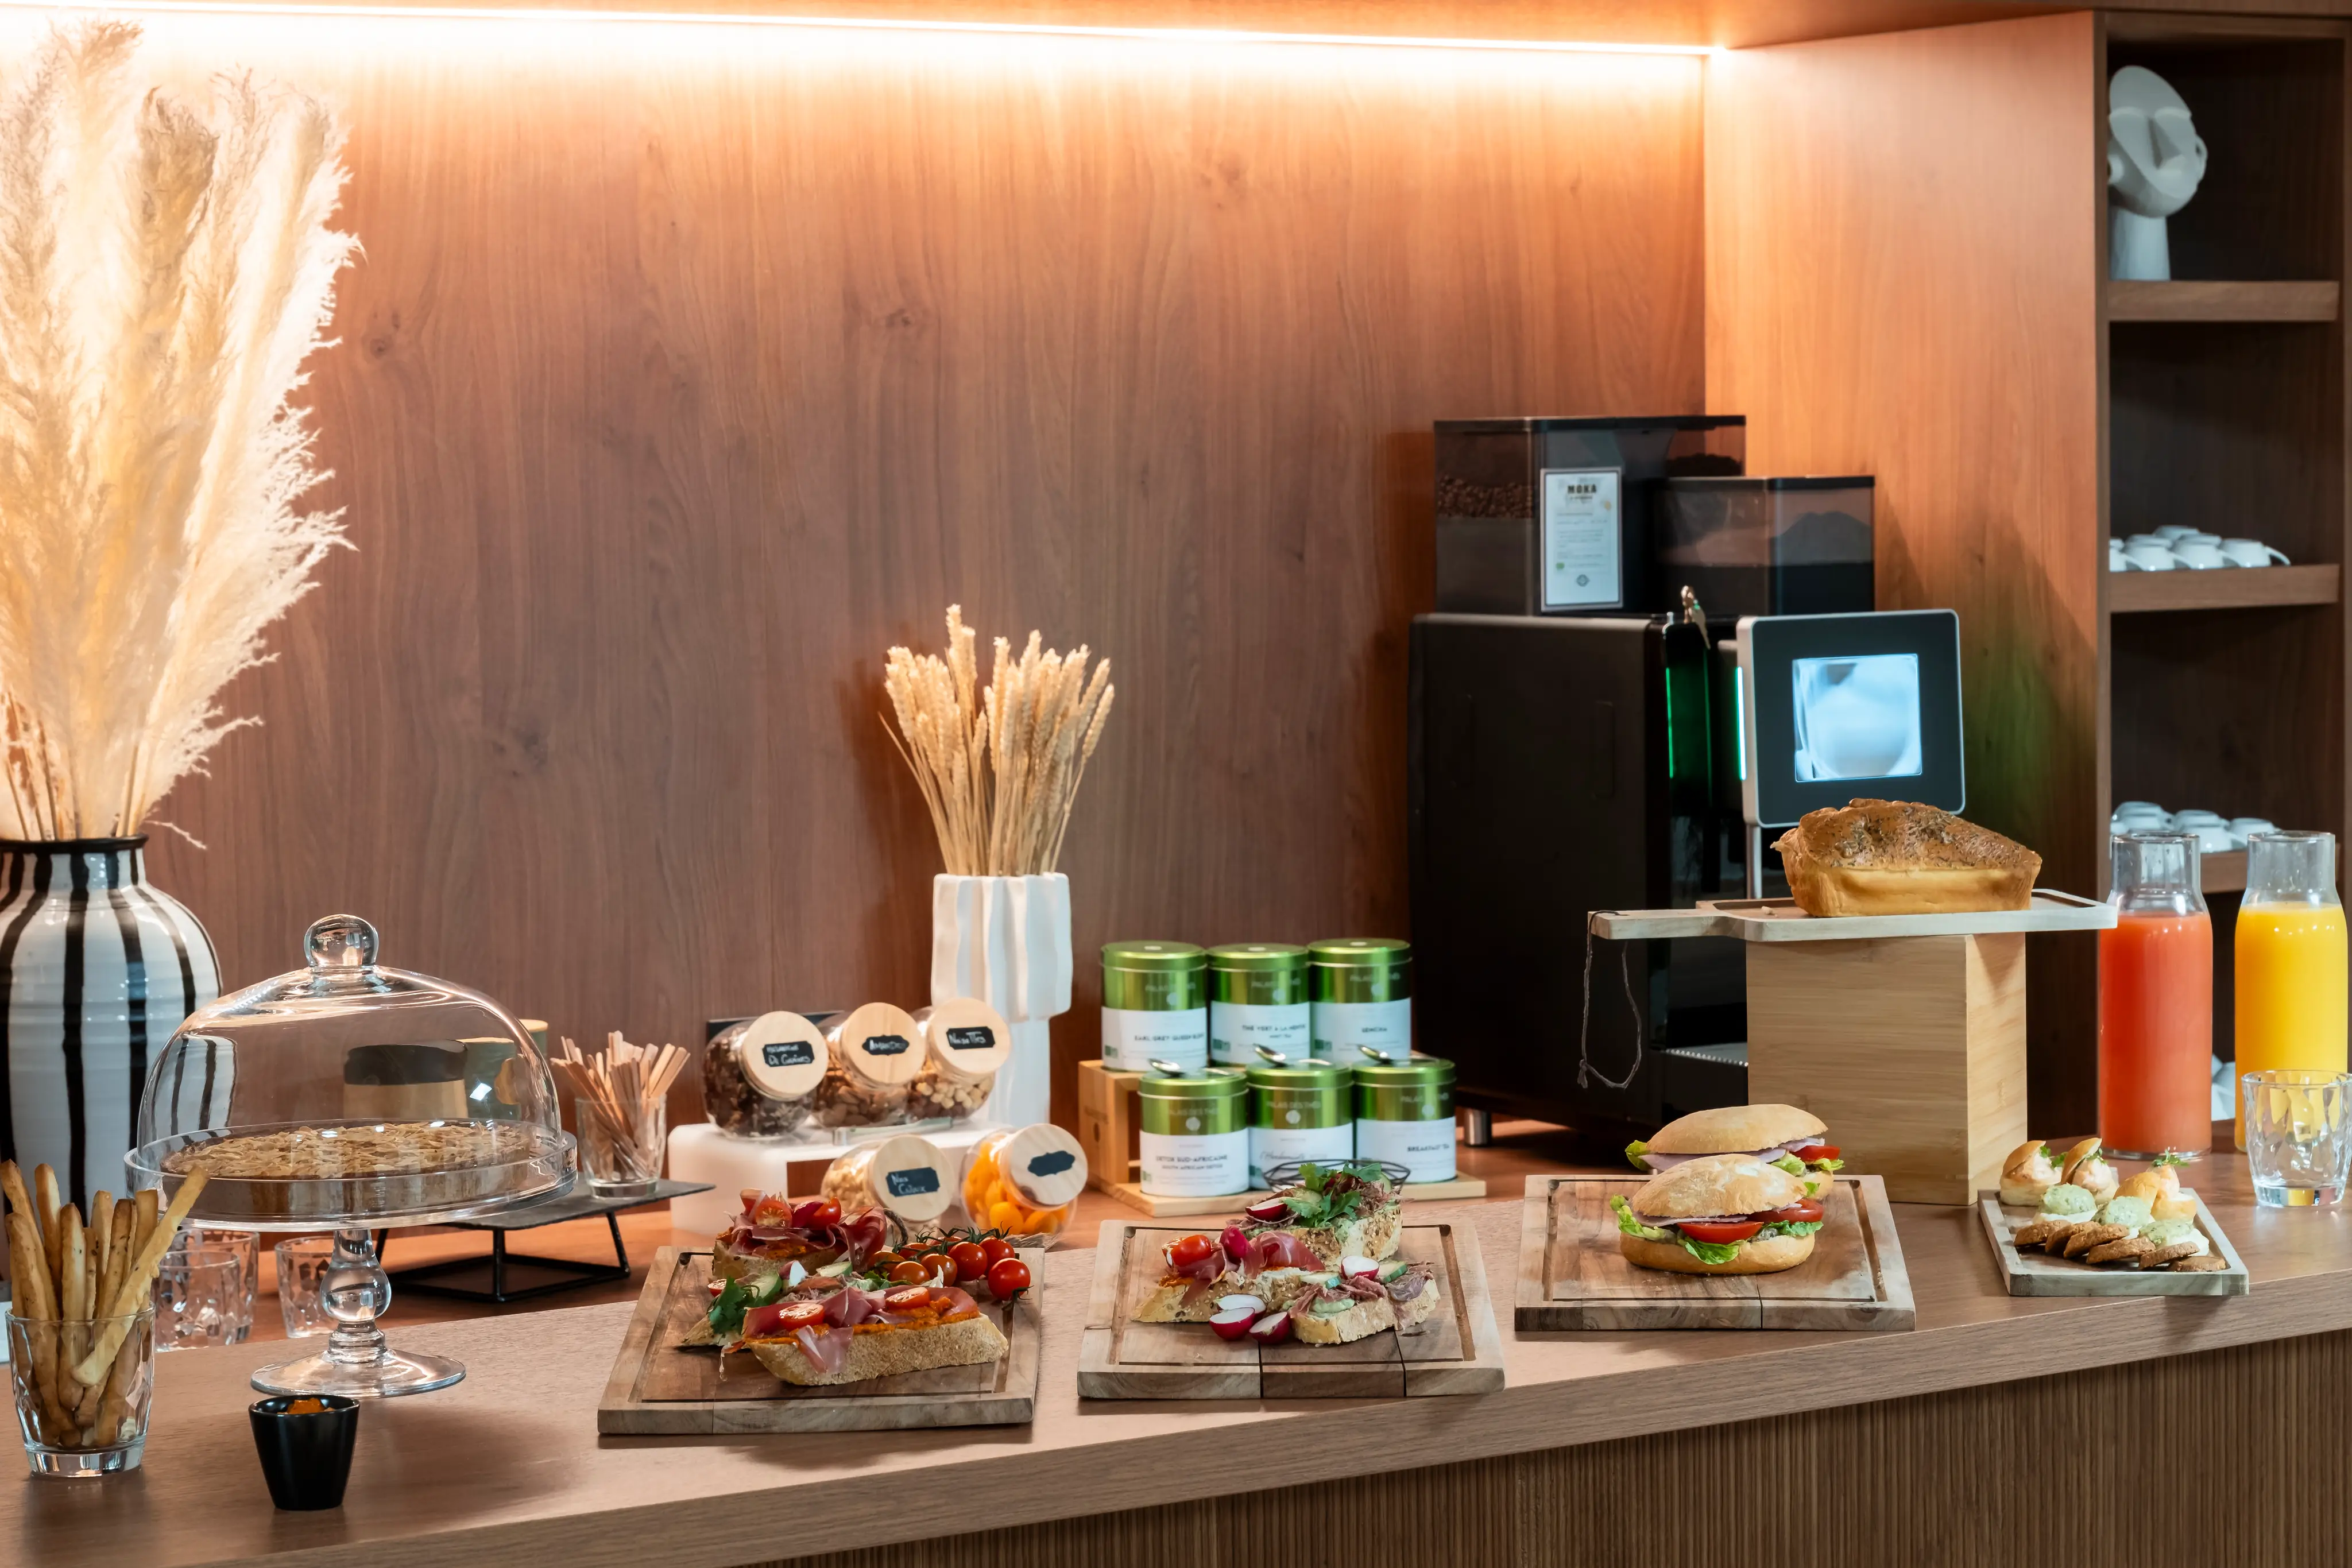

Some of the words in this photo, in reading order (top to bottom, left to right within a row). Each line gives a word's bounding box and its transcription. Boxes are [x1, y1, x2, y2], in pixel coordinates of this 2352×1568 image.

[1567, 484, 1597, 494] MOKA
[1134, 1034, 1151, 1042] EARL
[1152, 1033, 1170, 1042] GREY
[1155, 1155, 1175, 1163] DETOX
